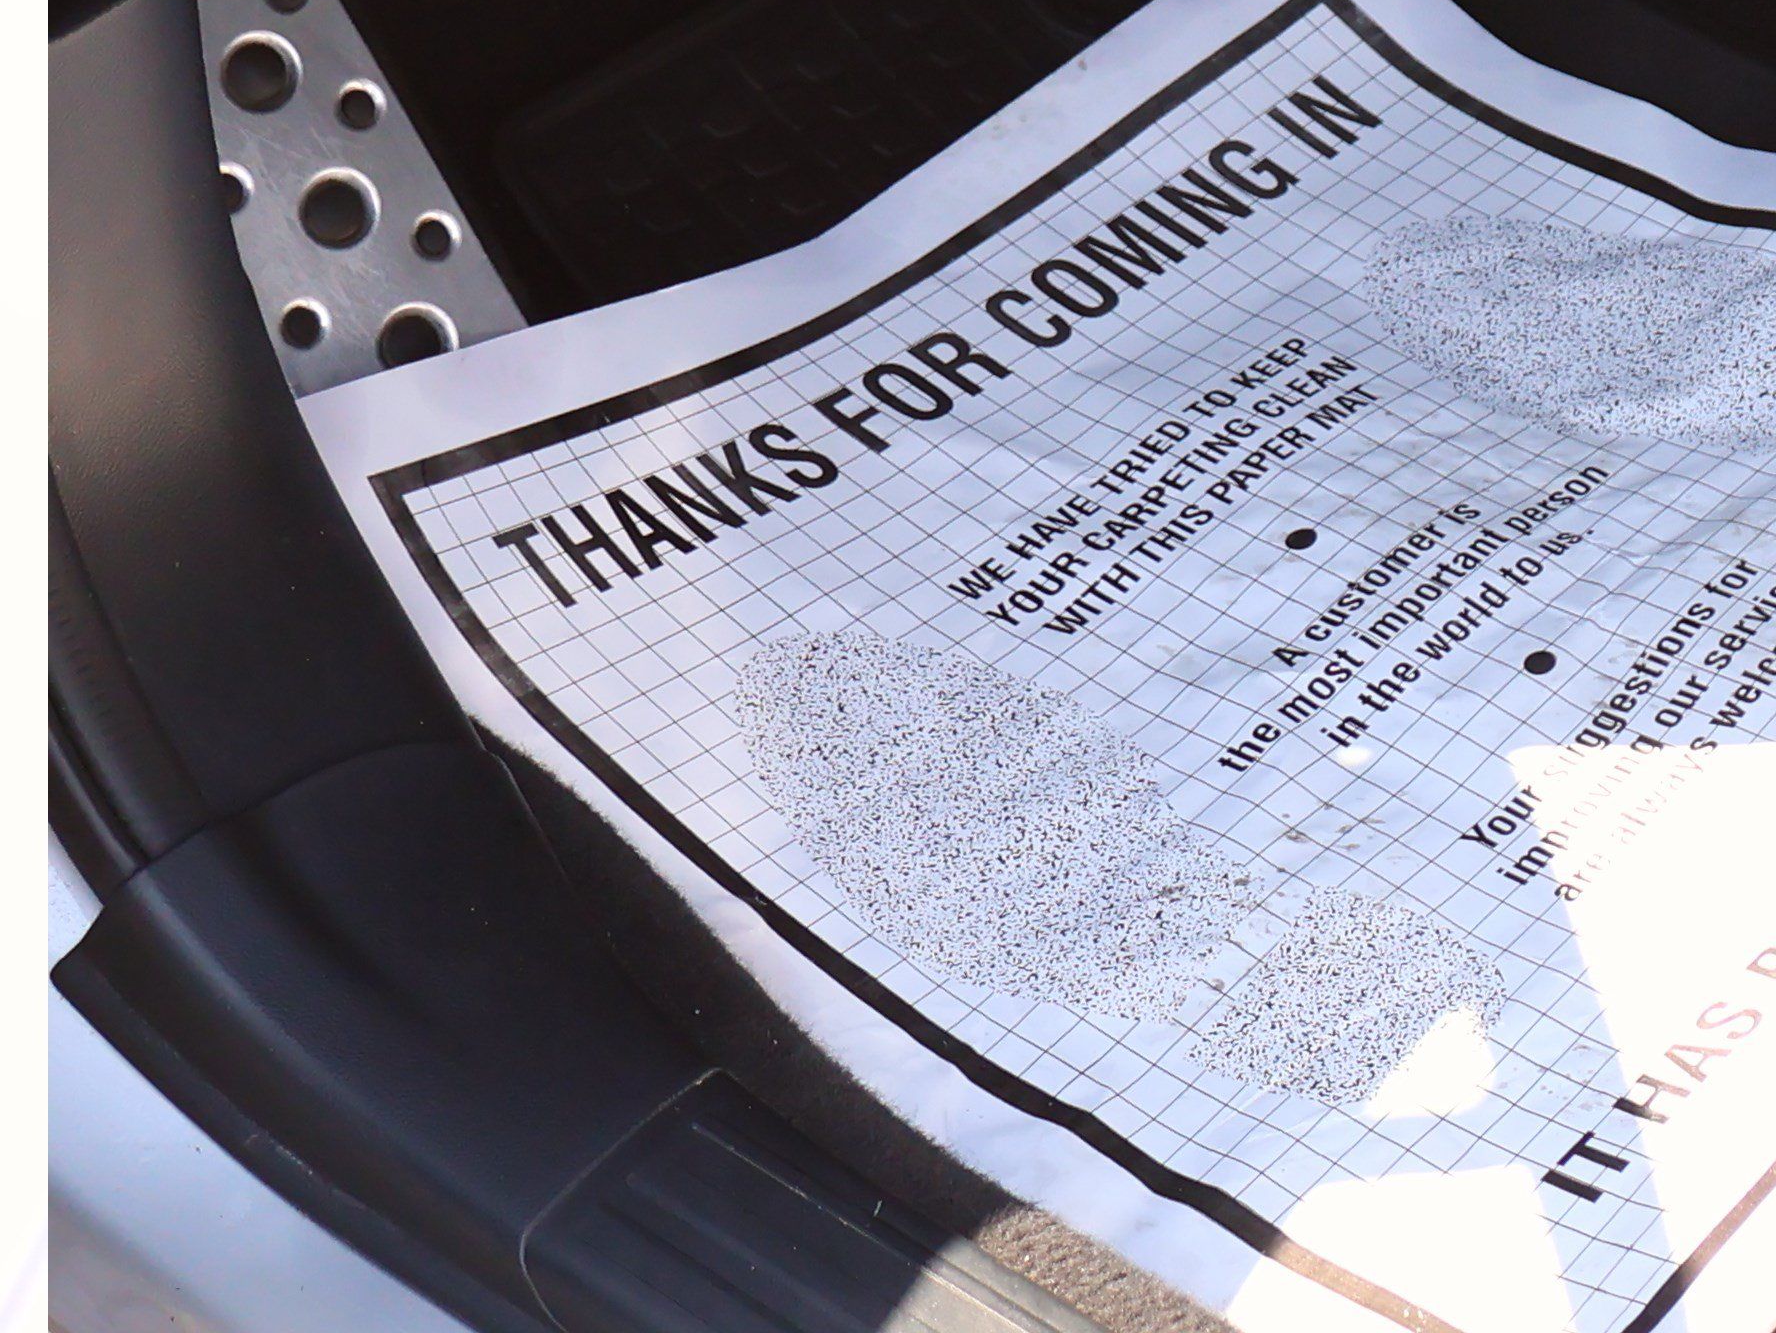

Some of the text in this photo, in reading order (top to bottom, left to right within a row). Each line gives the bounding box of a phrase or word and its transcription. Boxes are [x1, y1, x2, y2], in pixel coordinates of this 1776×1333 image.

[492, 75, 1385, 608] THANKS FOR COMING IN
[948, 336, 1308, 601] WE HAVE TRIED TO KEEP
[986, 355, 1359, 627] YOUR CARPETING CLEAN
[1043, 383, 1382, 636] WITH THIS PAPER MAT
[1218, 464, 1610, 774] the most important person
[1271, 501, 1483, 669] A customer is
[1318, 710, 1370, 749] in
[1358, 662, 1421, 713] the
[1416, 583, 1509, 663] world
[1499, 556, 1545, 586] to
[1460, 784, 1543, 851] Your
[1705, 557, 1759, 598] for
[1653, 671, 1707, 729] our
[1541, 1130, 1630, 1203] IT
[1612, 1000, 1764, 1125] HAS
